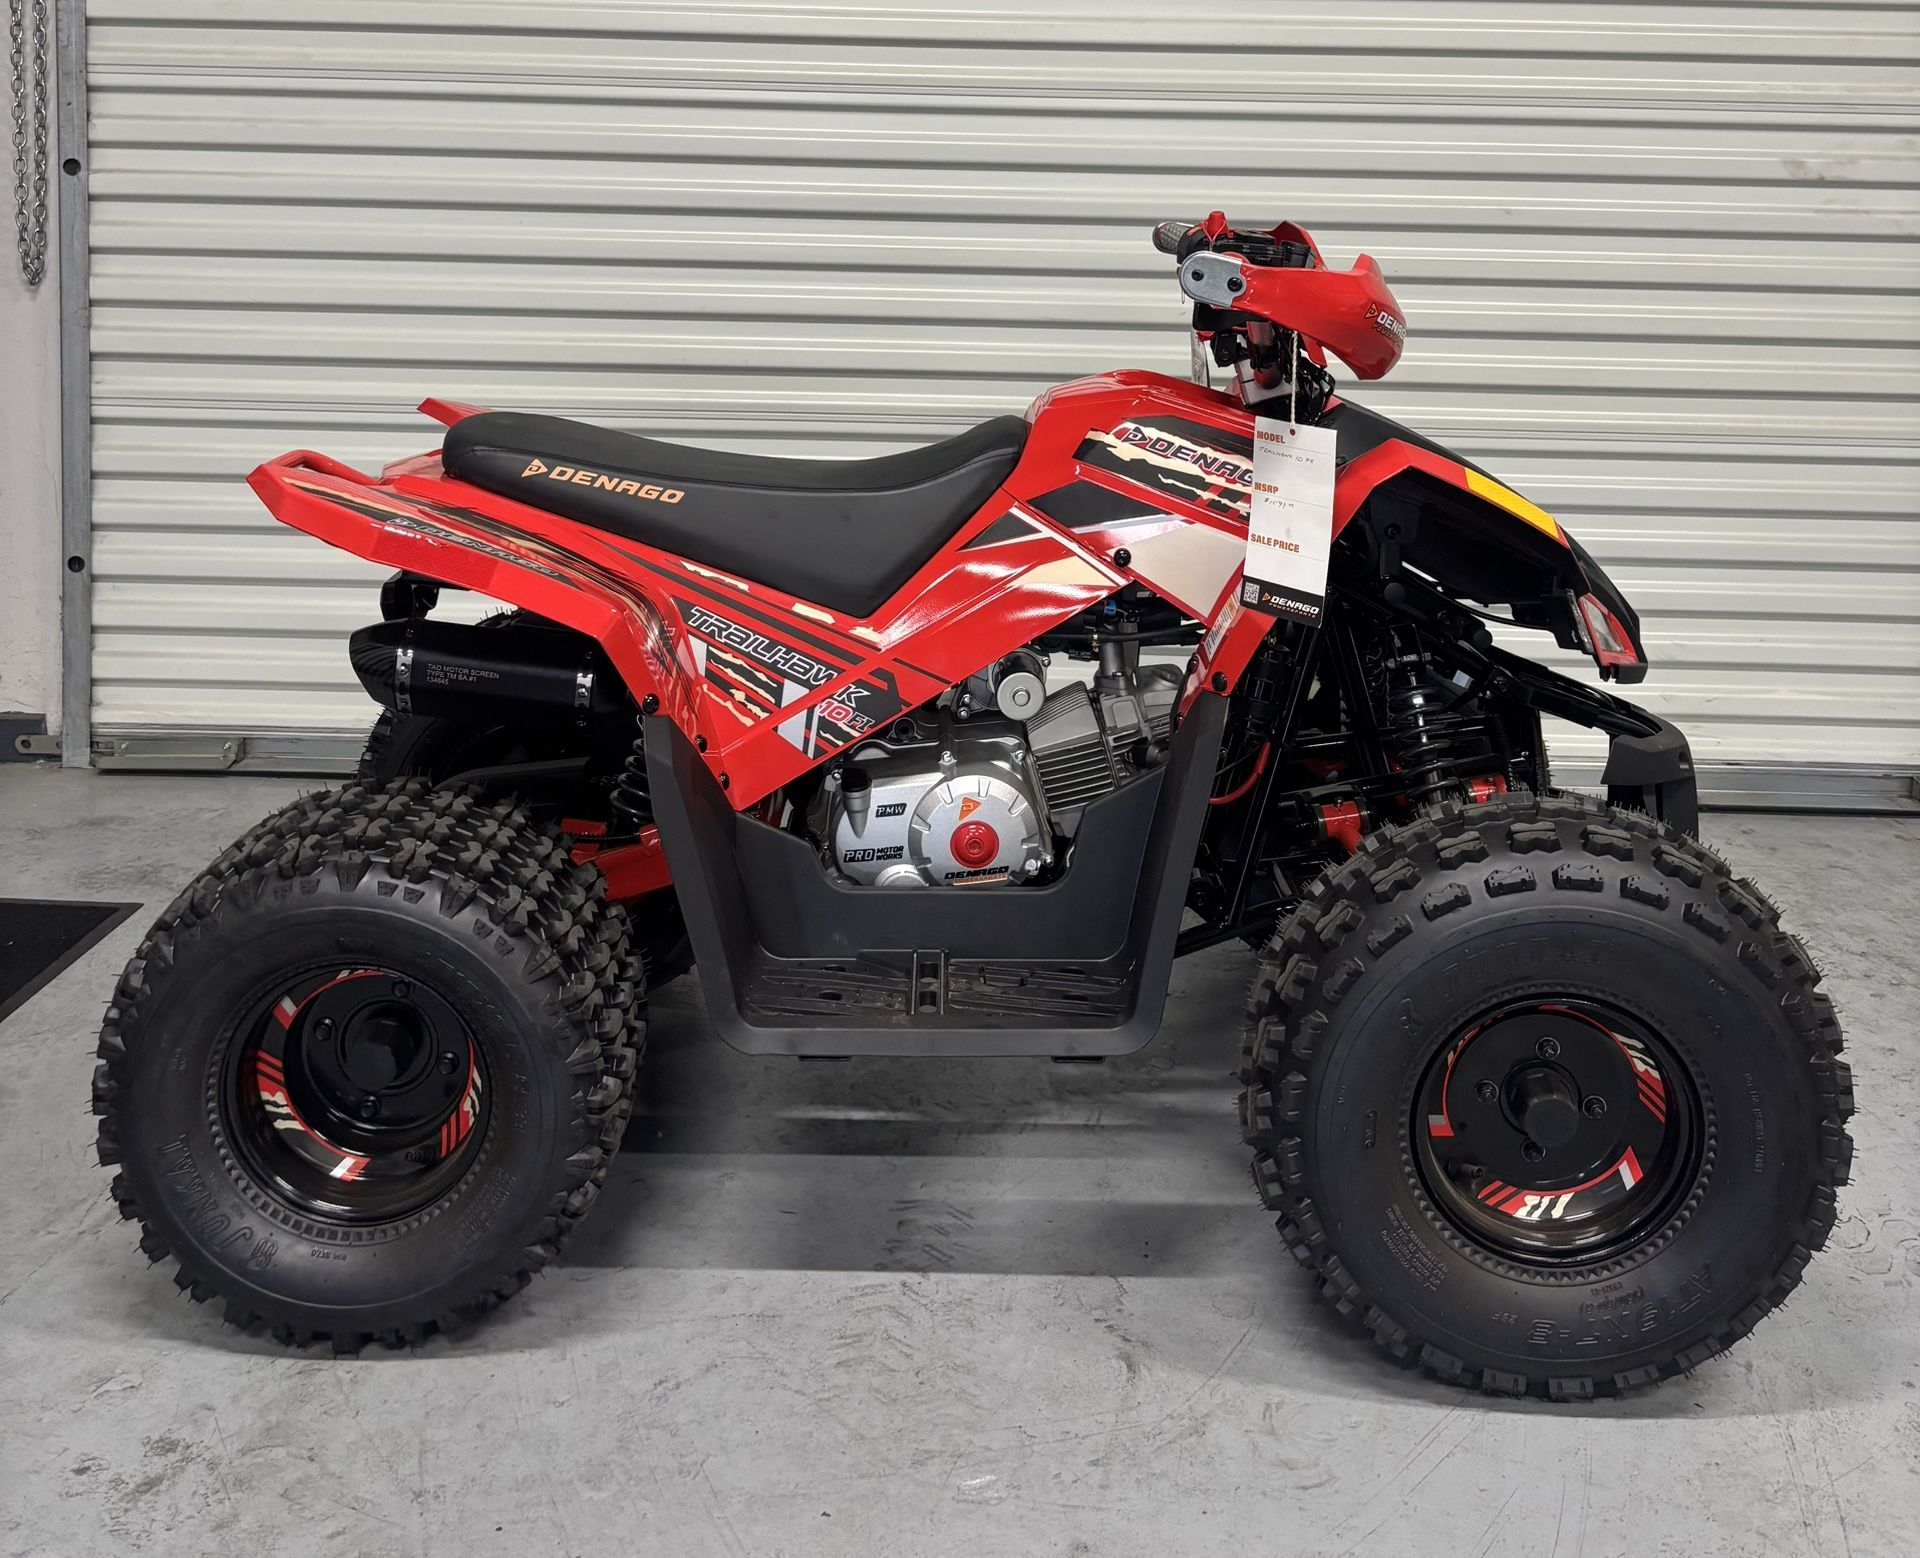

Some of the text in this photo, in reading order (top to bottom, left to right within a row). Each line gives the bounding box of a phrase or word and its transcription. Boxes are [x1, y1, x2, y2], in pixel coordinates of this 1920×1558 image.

[1257, 430, 1285, 444] MODEL
[549, 466, 685, 504] DENAGO
[1254, 482, 1279, 494] MSRP
[1250, 534, 1300, 553] SALE PRICE
[1269, 602, 1316, 618] POWERSPORTS
[1270, 595, 1320, 614] DENAGO
[427, 670, 445, 678] TYPE
[443, 666, 469, 675] MOTOR
[470, 669, 499, 679] SCREEN
[877, 804, 905, 816] PMW
[845, 849, 874, 862] PRO
[876, 845, 904, 854] MOTOR
[876, 852, 903, 861] WORKS
[944, 865, 1009, 879] DENAGO
